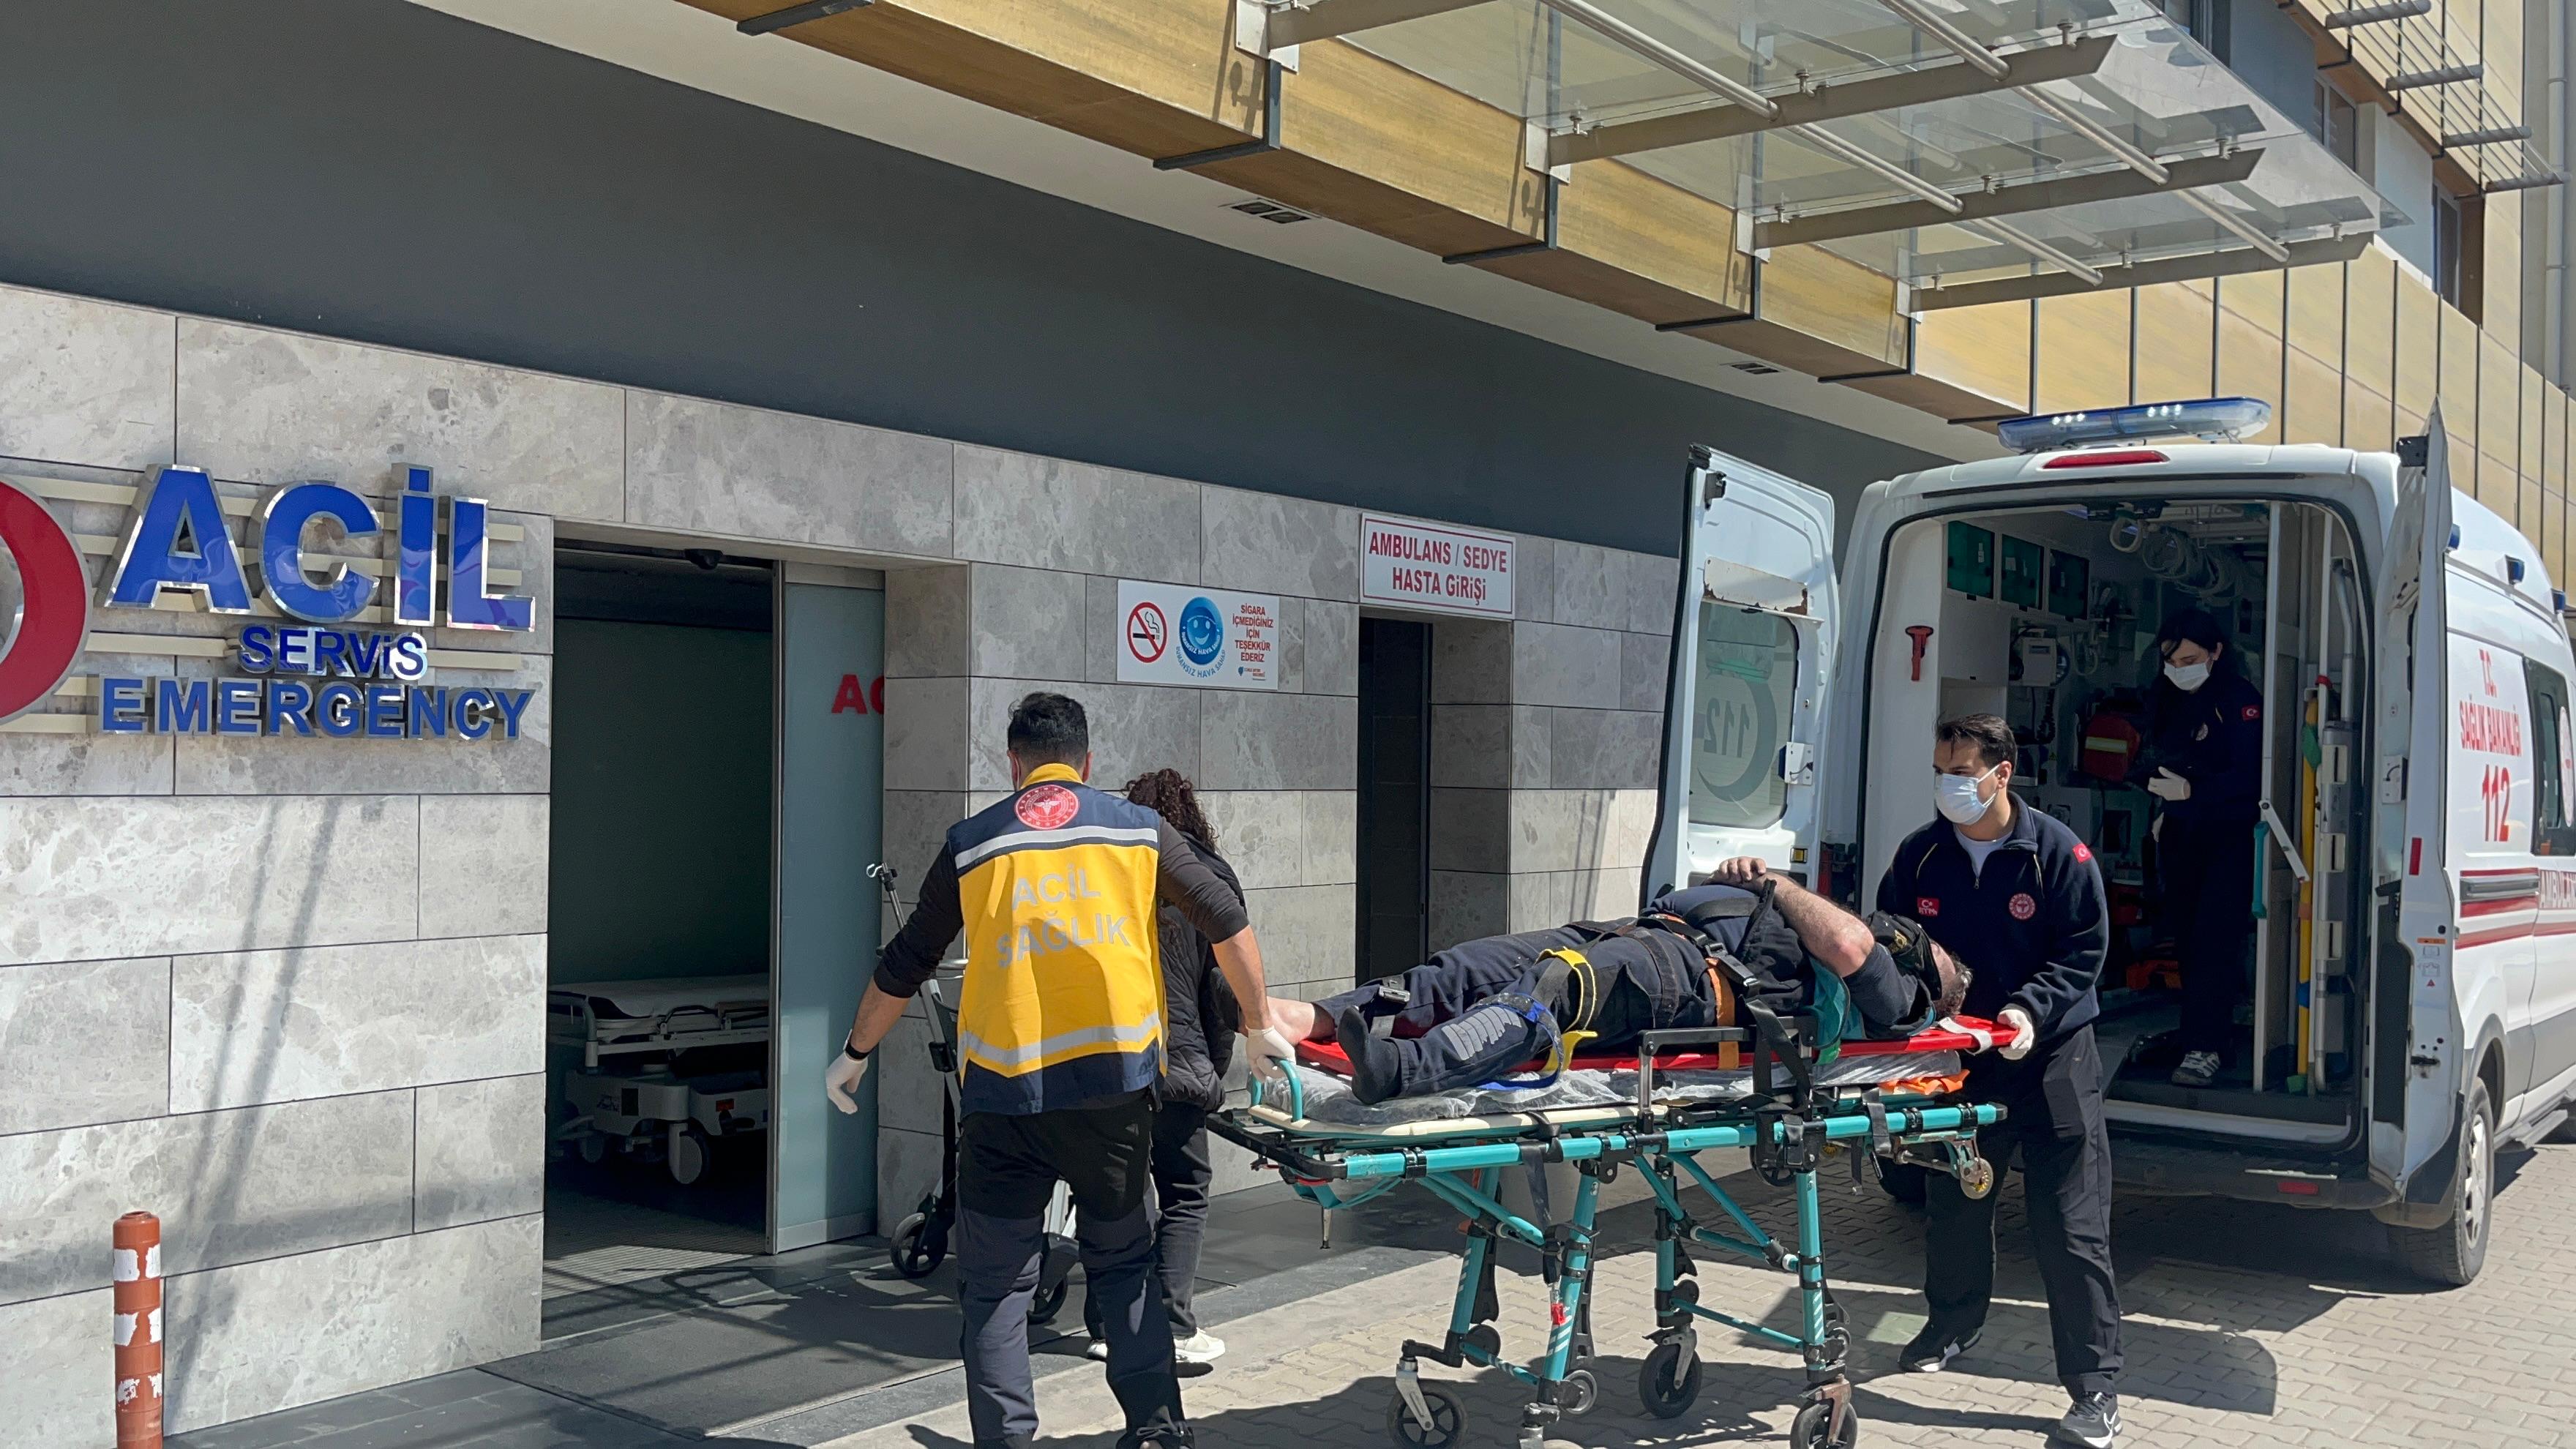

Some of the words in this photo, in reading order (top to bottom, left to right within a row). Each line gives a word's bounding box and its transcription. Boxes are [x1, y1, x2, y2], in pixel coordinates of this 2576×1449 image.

[95, 463, 536, 632] ACİL
[1368, 531, 1451, 565] AMBULANS
[1463, 544, 1508, 573] SEDYE
[1392, 566, 1442, 595] HASTA
[1240, 603, 1266, 615] SİGARA
[1235, 640, 1271, 651] TEŞEKKÜR
[1246, 626, 1260, 640] İÇİN
[1240, 651, 1265, 662] EDERİZ
[100, 675, 536, 741] EMERGENCY
[2482, 764, 2511, 842] 112
[1012, 863, 1101, 910] ACİL
[996, 910, 1131, 969] SAĞLIK
